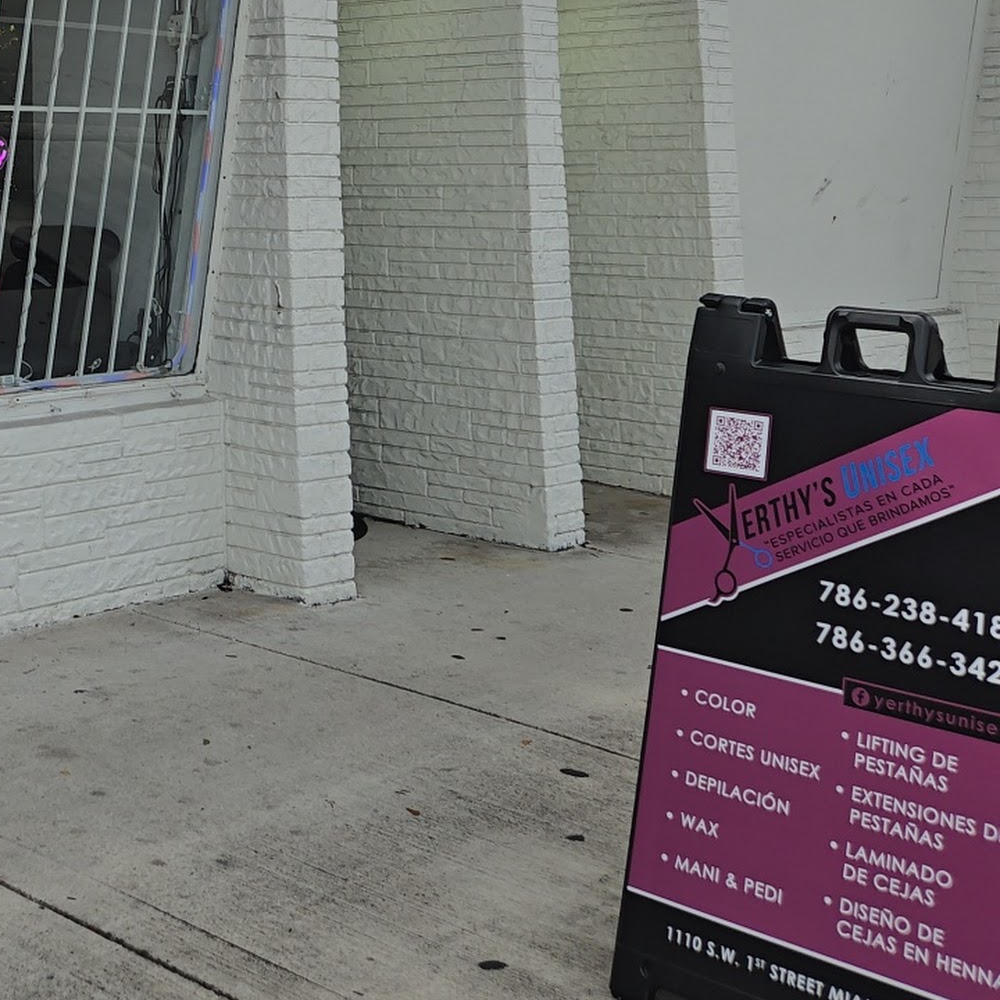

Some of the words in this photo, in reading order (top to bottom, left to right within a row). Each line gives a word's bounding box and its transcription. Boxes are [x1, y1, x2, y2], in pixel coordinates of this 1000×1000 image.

[839, 436, 935, 499] UNISEX
[878, 489, 898, 507] EN
[902, 473, 944, 497] CADA
[775, 532, 834, 563] SERVICIO
[836, 522, 867, 539] QUE
[819, 580, 1000, 640] 786-238-418
[815, 621, 1000, 686] 786-366-342
[695, 689, 757, 719] COLOR
[873, 693, 1000, 736] yerthysunise
[690, 729, 754, 761] CORTES
[760, 749, 821, 781] UNISEX
[854, 752, 949, 793] PESTAÑAS
[856, 732, 926, 763] LIFTING
[932, 751, 959, 773] DE
[685, 770, 790, 816] DEPILACIÓN
[851, 785, 977, 836] EXTENSIONES
[983, 823, 1000, 843] D
[680, 811, 720, 838] WAX
[849, 808, 944, 850] PESTAÑAS
[674, 854, 720, 883] MANI
[725, 872, 738, 890] &
[743, 877, 783, 905] PEDI
[842, 863, 868, 886] DE
[873, 873, 936, 908] CEJAS
[845, 841, 953, 889] LAMINADO
[836, 920, 898, 955] CEJAS
[903, 941, 930, 966] EN
[839, 897, 911, 935] DISEÑO
[917, 922, 945, 947] DE
[666, 925, 702, 952] 1110
[706, 940, 740, 968] S.W.
[769, 963, 825, 997] STREET
